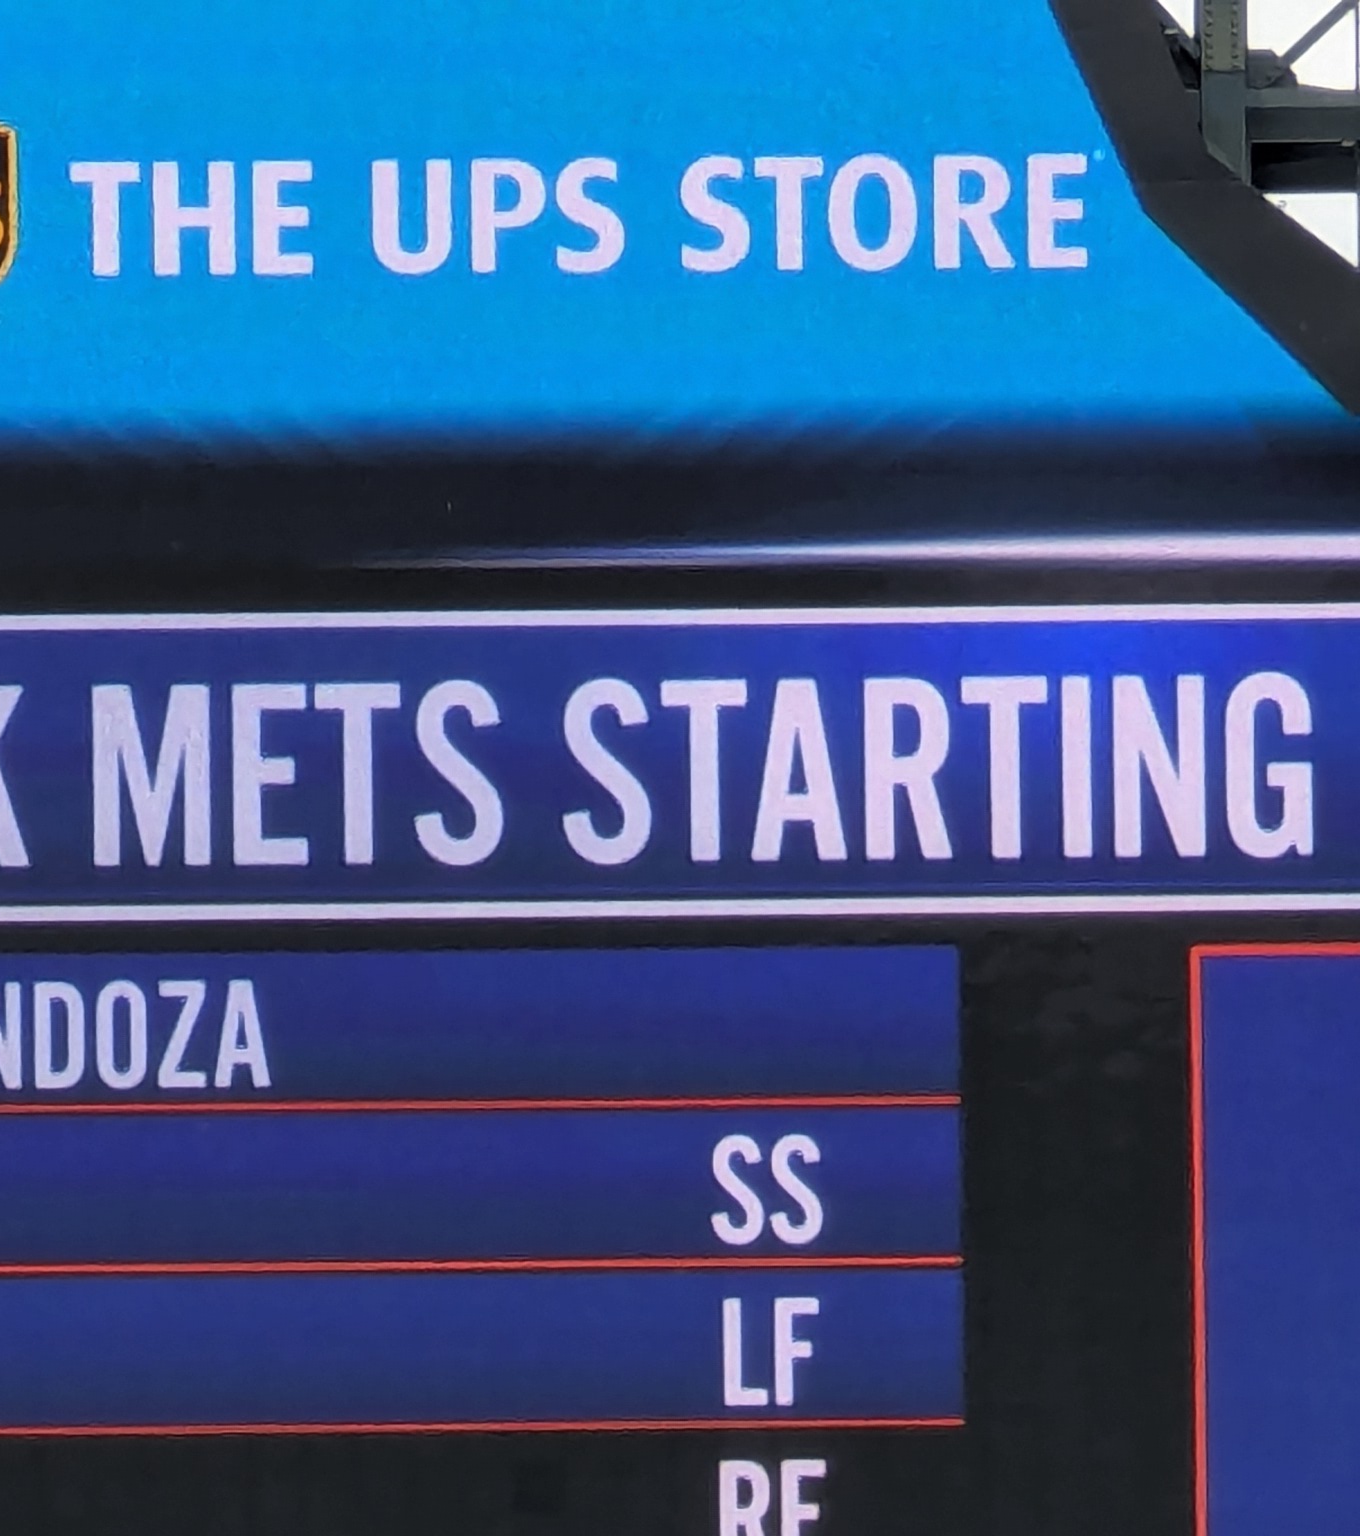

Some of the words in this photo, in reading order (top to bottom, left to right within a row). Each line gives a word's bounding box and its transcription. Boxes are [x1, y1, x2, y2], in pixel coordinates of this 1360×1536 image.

[69, 160, 314, 277] THE
[371, 157, 625, 275] UPS
[680, 153, 1088, 273] STORE
[91, 679, 504, 867] METS
[562, 671, 1314, 865] STARTING
[710, 1134, 824, 1246] SS
[722, 1296, 820, 1407] LF
